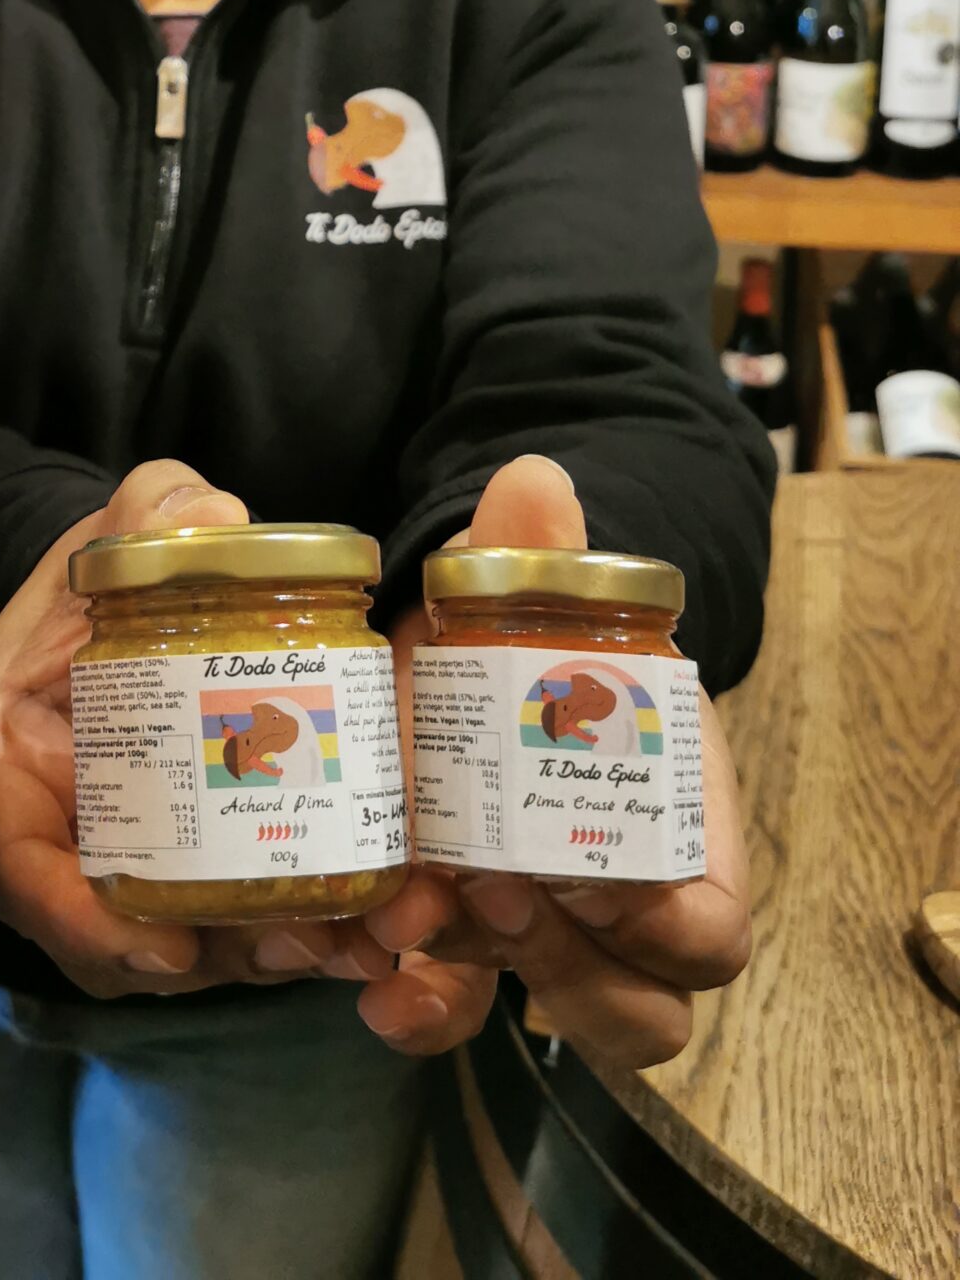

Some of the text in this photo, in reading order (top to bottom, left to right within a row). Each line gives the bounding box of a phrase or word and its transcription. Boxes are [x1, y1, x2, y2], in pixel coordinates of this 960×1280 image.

[114, 661, 142, 669] pepertjes
[203, 653, 326, 682] Ti Dodo Epicé
[121, 680, 165, 688] mosterdzaad.
[164, 690, 187, 698] apple,
[129, 703, 148, 712] garlic,
[440, 717, 459, 726] Vegan
[118, 726, 139, 734] Vegan
[147, 724, 175, 732] Vegan.
[125, 739, 157, 748] per 100g
[459, 734, 473, 744] 100g
[128, 750, 148, 758] 100g:
[160, 760, 173, 768] 212
[168, 771, 192, 779] 17.7 g
[539, 758, 650, 788] Ti Dodo Epicé
[221, 793, 334, 815] Achard Pima
[523, 793, 565, 808] Pima
[625, 799, 665, 822] Rouge
[177, 826, 197, 835] 1.6 g
[177, 837, 189, 845] 2.7
[271, 851, 298, 868] 100g
[585, 851, 608, 869] 40g
